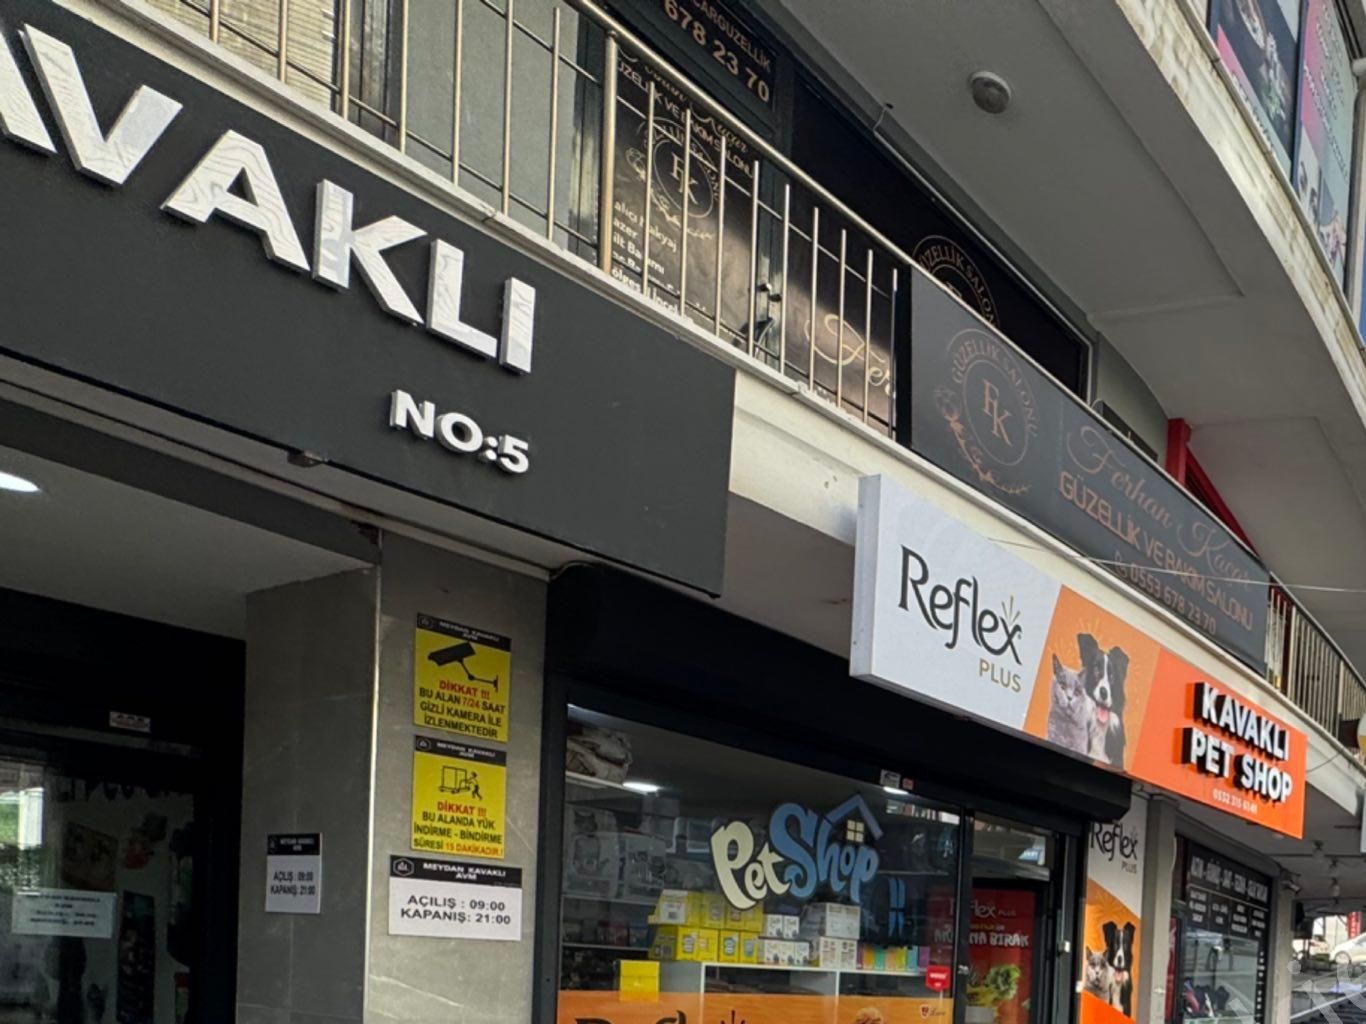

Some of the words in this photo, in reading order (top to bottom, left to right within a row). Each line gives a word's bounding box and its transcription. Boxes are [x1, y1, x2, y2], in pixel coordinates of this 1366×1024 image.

[664, 0, 706, 46] 678
[712, 39, 739, 75] 23
[745, 67, 770, 102] 70
[390, 389, 530, 474] NO:5
[1059, 471, 1141, 551] GÜZELLİK
[1143, 531, 1163, 567] VE
[1205, 580, 1254, 631] SALONU
[898, 544, 1024, 667] Reflex
[439, 680, 478, 697] DİKKAT
[979, 658, 1022, 693] PLUS
[419, 687, 433, 698] BU
[435, 691, 461, 705] ALAN
[462, 697, 481, 709] 7/24
[481, 701, 505, 715] SAAT
[420, 701, 445, 715] GİZLİ
[446, 707, 487, 725] KAMERA
[488, 714, 502, 727] İLE
[424, 713, 498, 738] İZLENMEKTEDİR
[1201, 682, 1290, 762] KAVAKLI
[1190, 727, 1234, 778] PET
[1241, 753, 1293, 804] SHOP
[422, 811, 436, 821] BU
[437, 813, 475, 827] ALANDA
[476, 817, 496, 830] YÜK
[437, 800, 475, 815] DİKKAT
[414, 822, 452, 838] İNDİRME
[459, 828, 503, 845] BİNDİRME
[1090, 820, 1138, 862] Reflex
[423, 862, 466, 874] MEYDAN
[468, 866, 506, 878] KAVAKLI
[455, 872, 477, 881] AVM
[407, 895, 457, 909] AÇILIŞ
[469, 900, 506, 912] 09:00
[475, 912, 511, 925] 21:00
